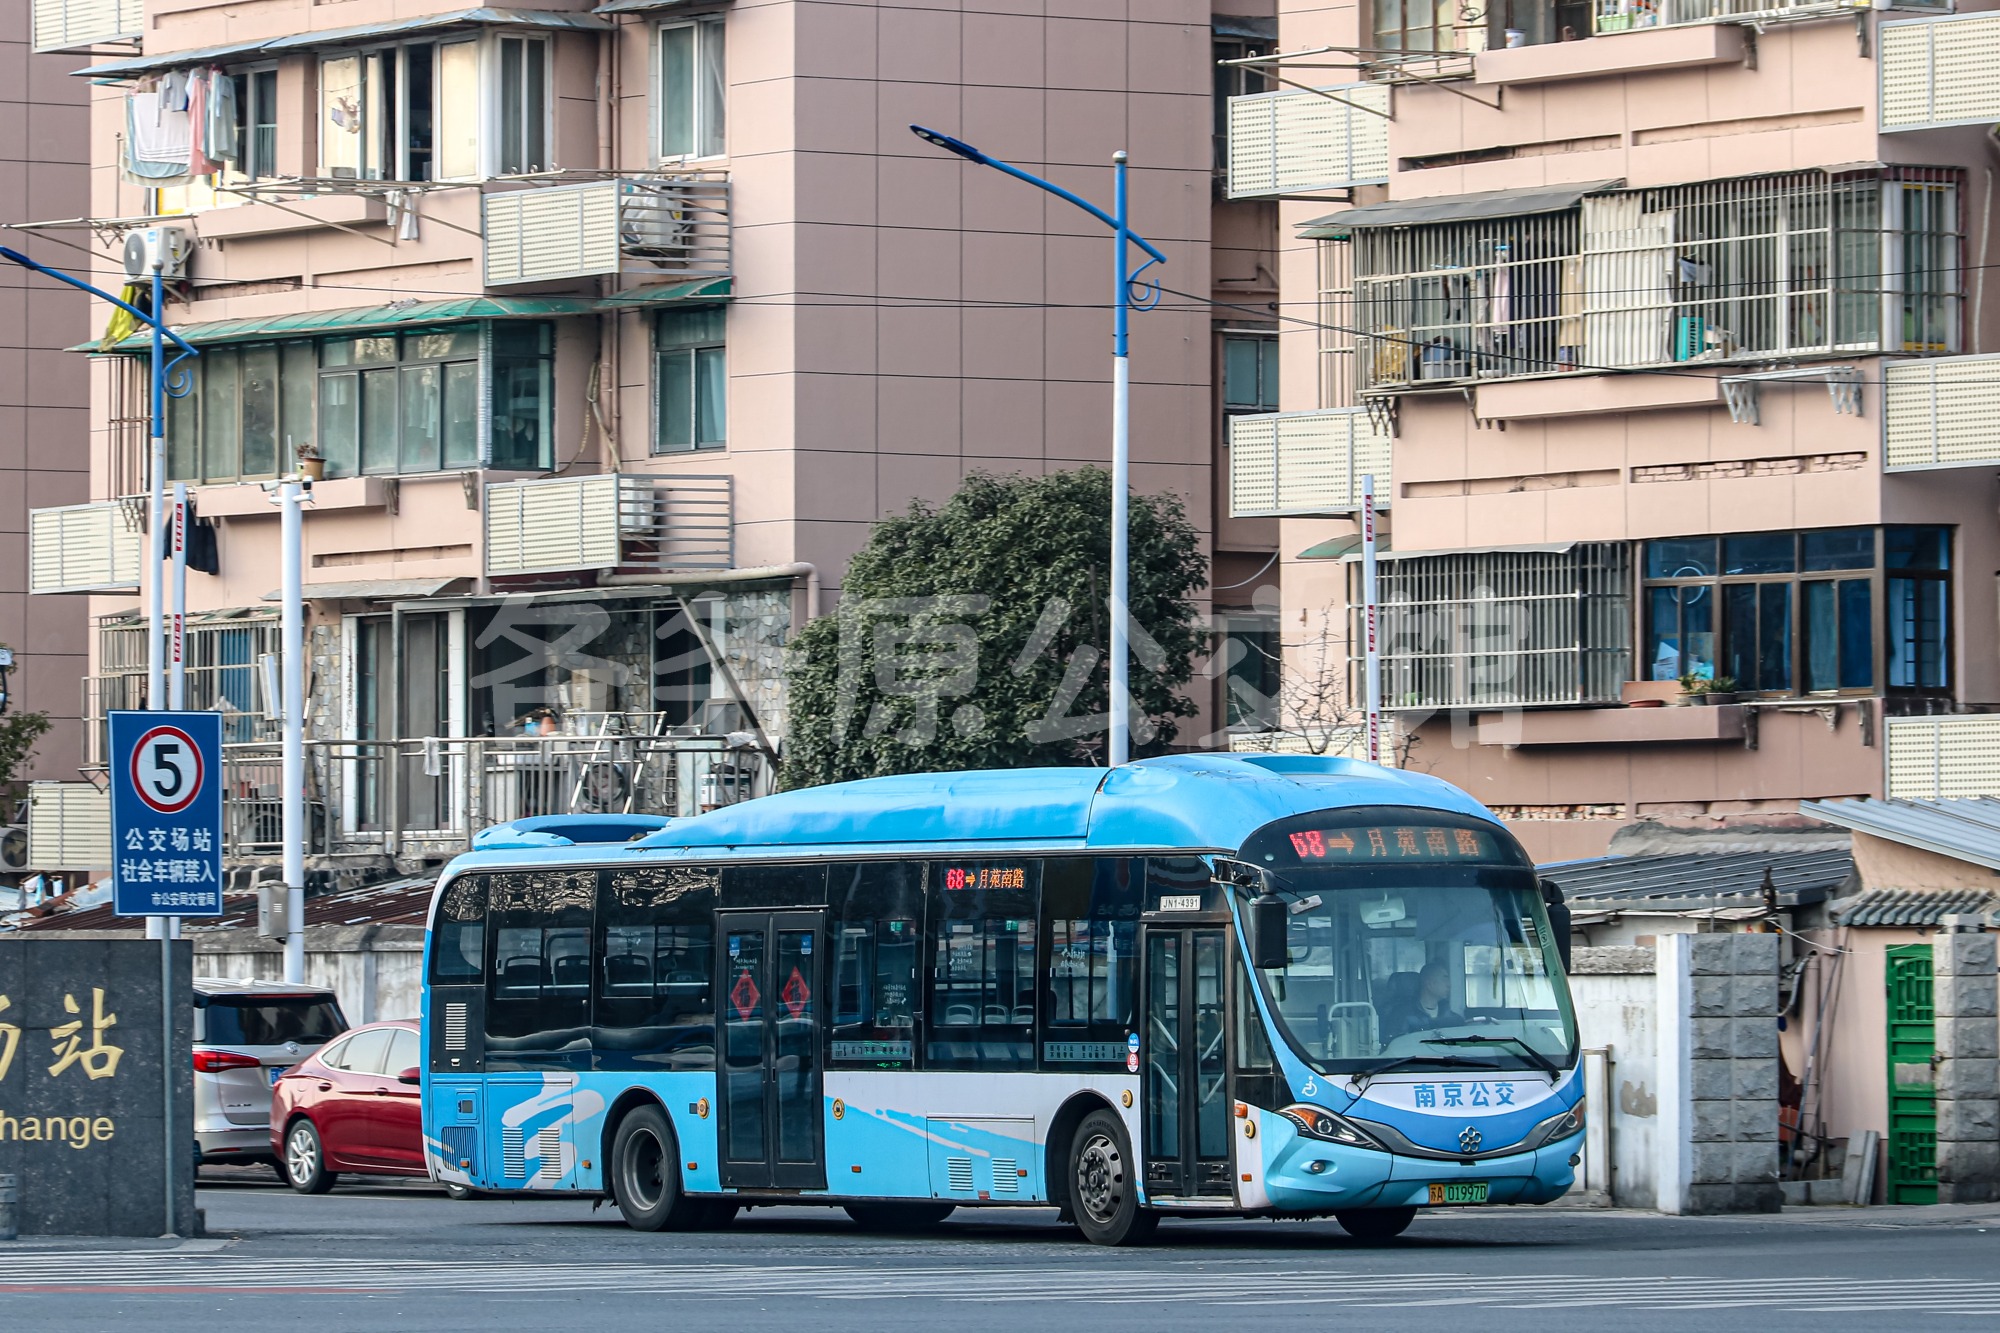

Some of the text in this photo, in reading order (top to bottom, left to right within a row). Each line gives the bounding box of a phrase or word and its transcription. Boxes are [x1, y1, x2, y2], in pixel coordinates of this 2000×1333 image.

[153, 743, 182, 797] 5
[125, 827, 212, 852] 公交场站
[1288, 828, 1480, 858] 68 月苑南路
[121, 858, 216, 884] 社会车辆禁入
[946, 867, 1025, 889] 68 月苑南路
[151, 892, 216, 906] 市公安局交管局
[1163, 898, 1198, 908] JN1-4391
[1412, 1081, 1515, 1109] 南京公交
